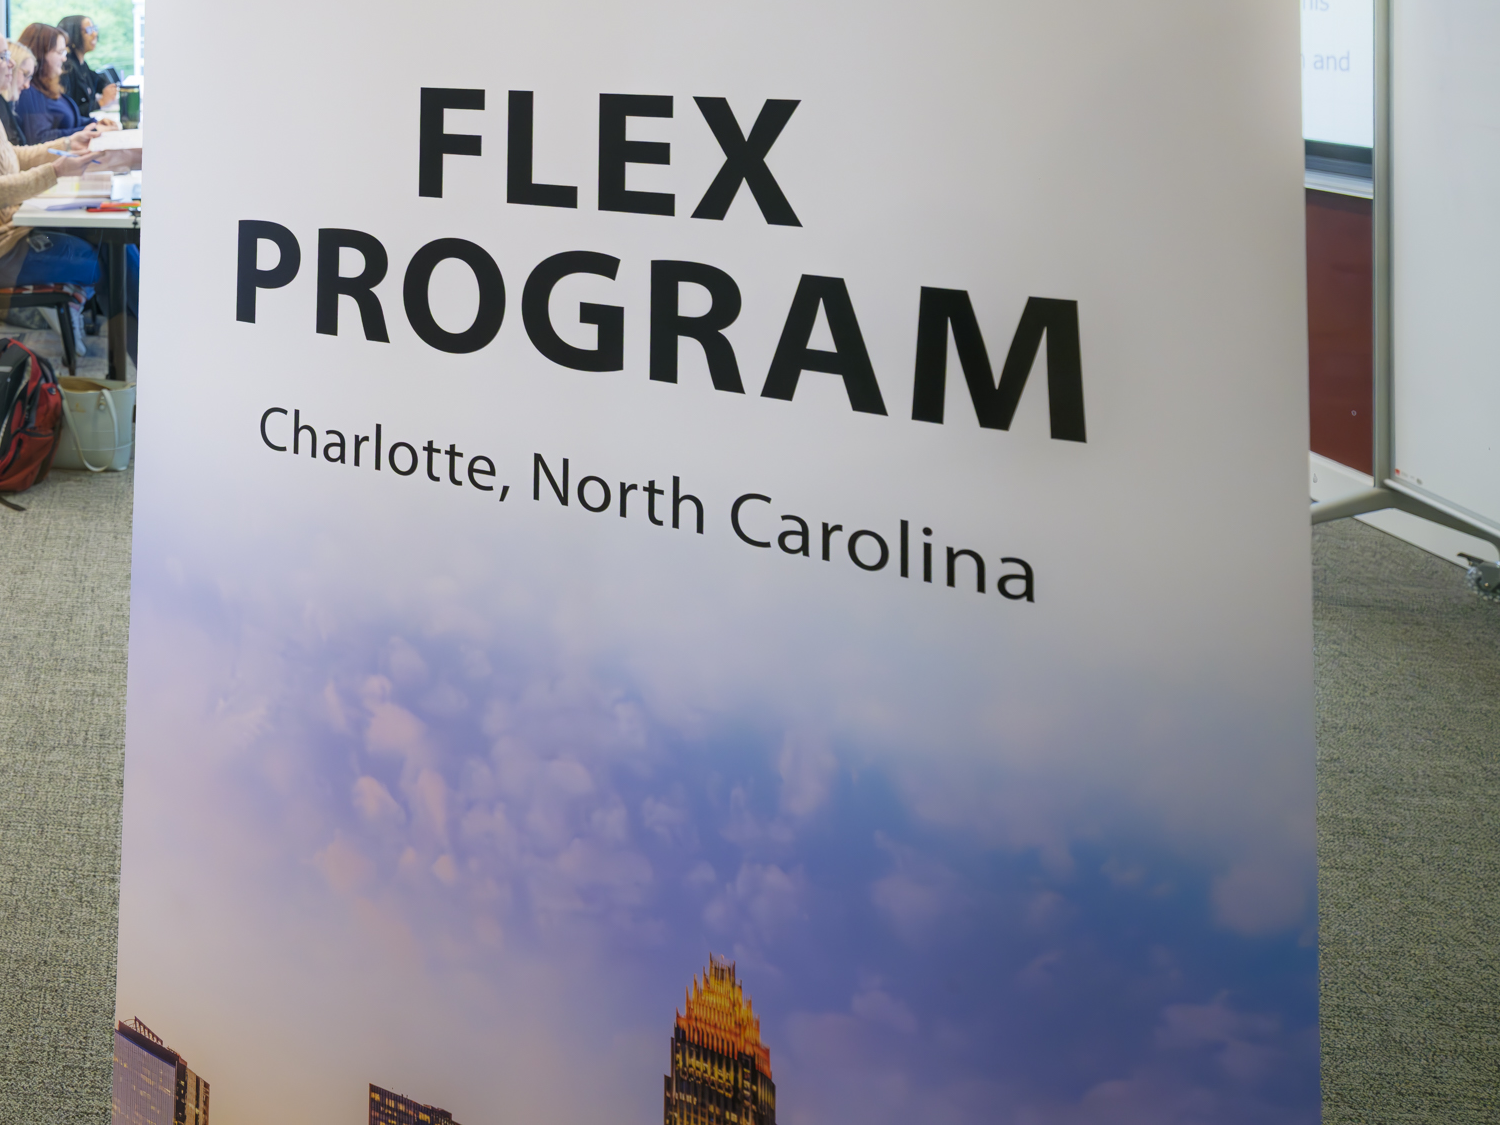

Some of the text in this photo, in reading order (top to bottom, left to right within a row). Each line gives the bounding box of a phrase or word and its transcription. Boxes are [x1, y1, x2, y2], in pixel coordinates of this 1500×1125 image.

[1313, 50, 1351, 72] and
[419, 87, 803, 227] FLEX
[236, 220, 1086, 443] PROGRAM
[259, 406, 1035, 603] Charlotte, North Carolina
